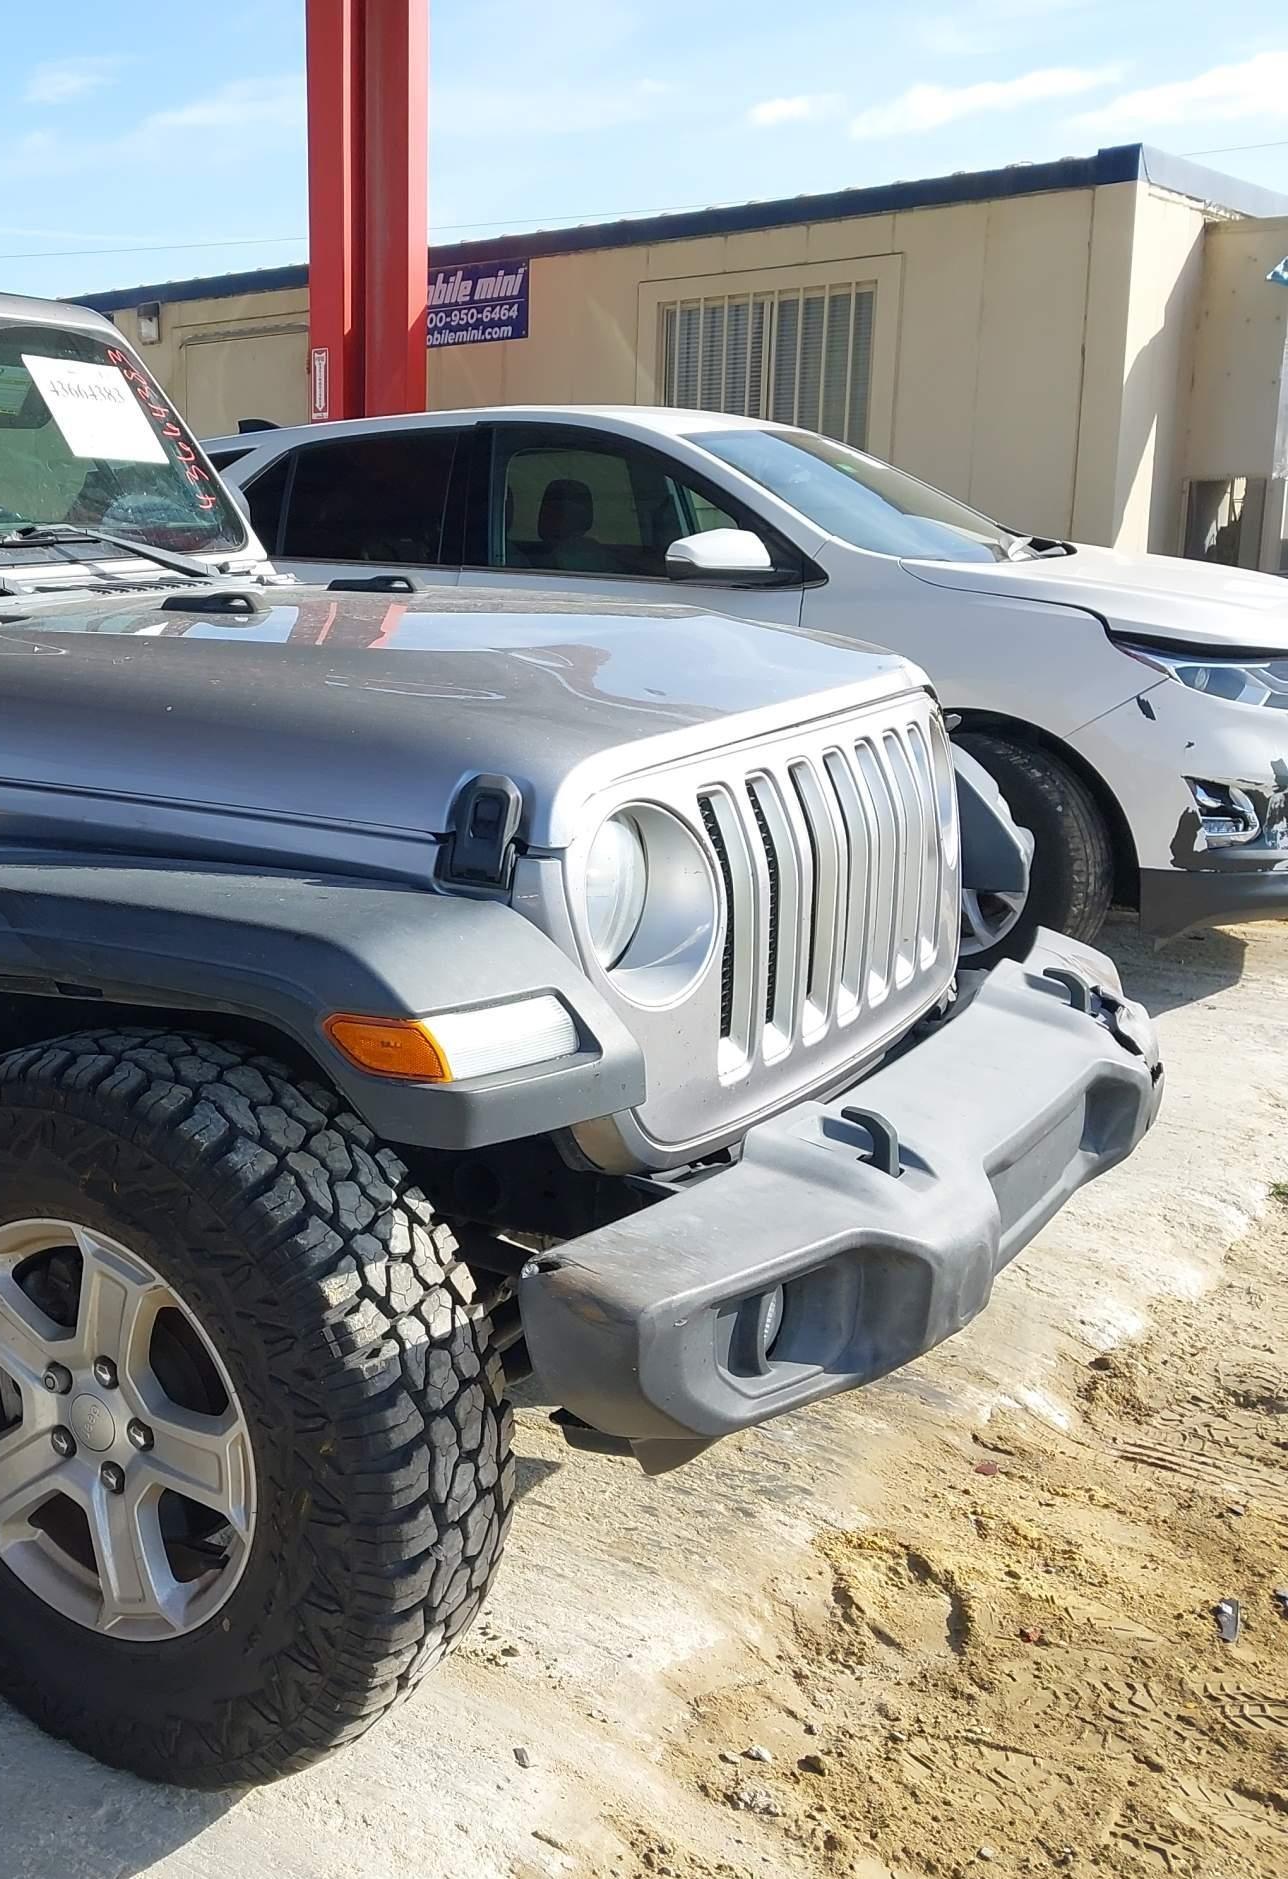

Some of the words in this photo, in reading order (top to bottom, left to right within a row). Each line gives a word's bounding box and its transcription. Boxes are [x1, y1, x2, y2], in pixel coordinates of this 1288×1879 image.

[474, 268, 524, 300] mini
[427, 304, 518, 328] 00-950-6464
[427, 326, 513, 346] obilemini.com
[49, 377, 126, 404] 43664383
